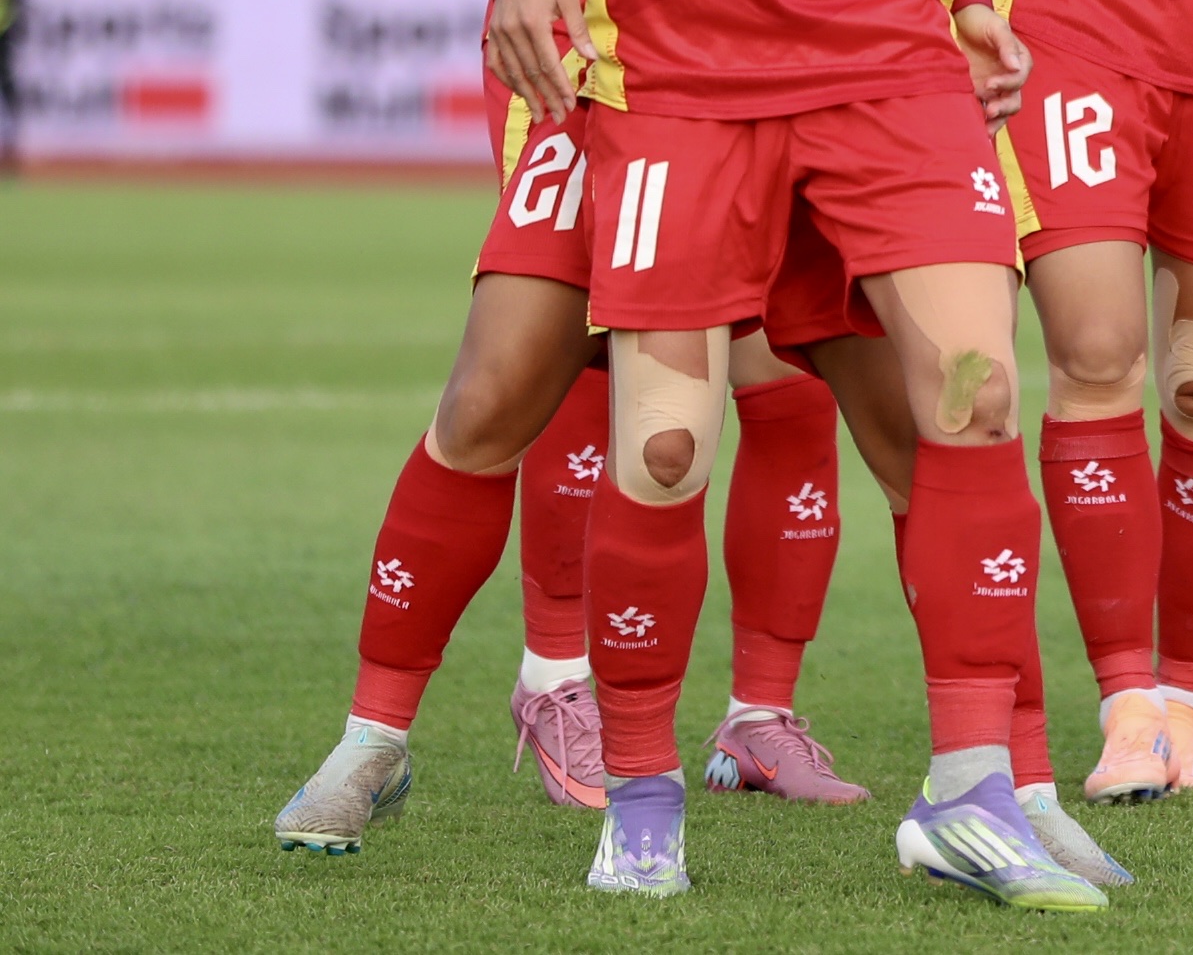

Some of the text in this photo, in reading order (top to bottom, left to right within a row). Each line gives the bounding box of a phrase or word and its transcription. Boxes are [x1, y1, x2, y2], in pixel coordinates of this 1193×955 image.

[508, 132, 587, 231] 21
[1044, 91, 1118, 189] 12
[611, 157, 669, 272] 11
